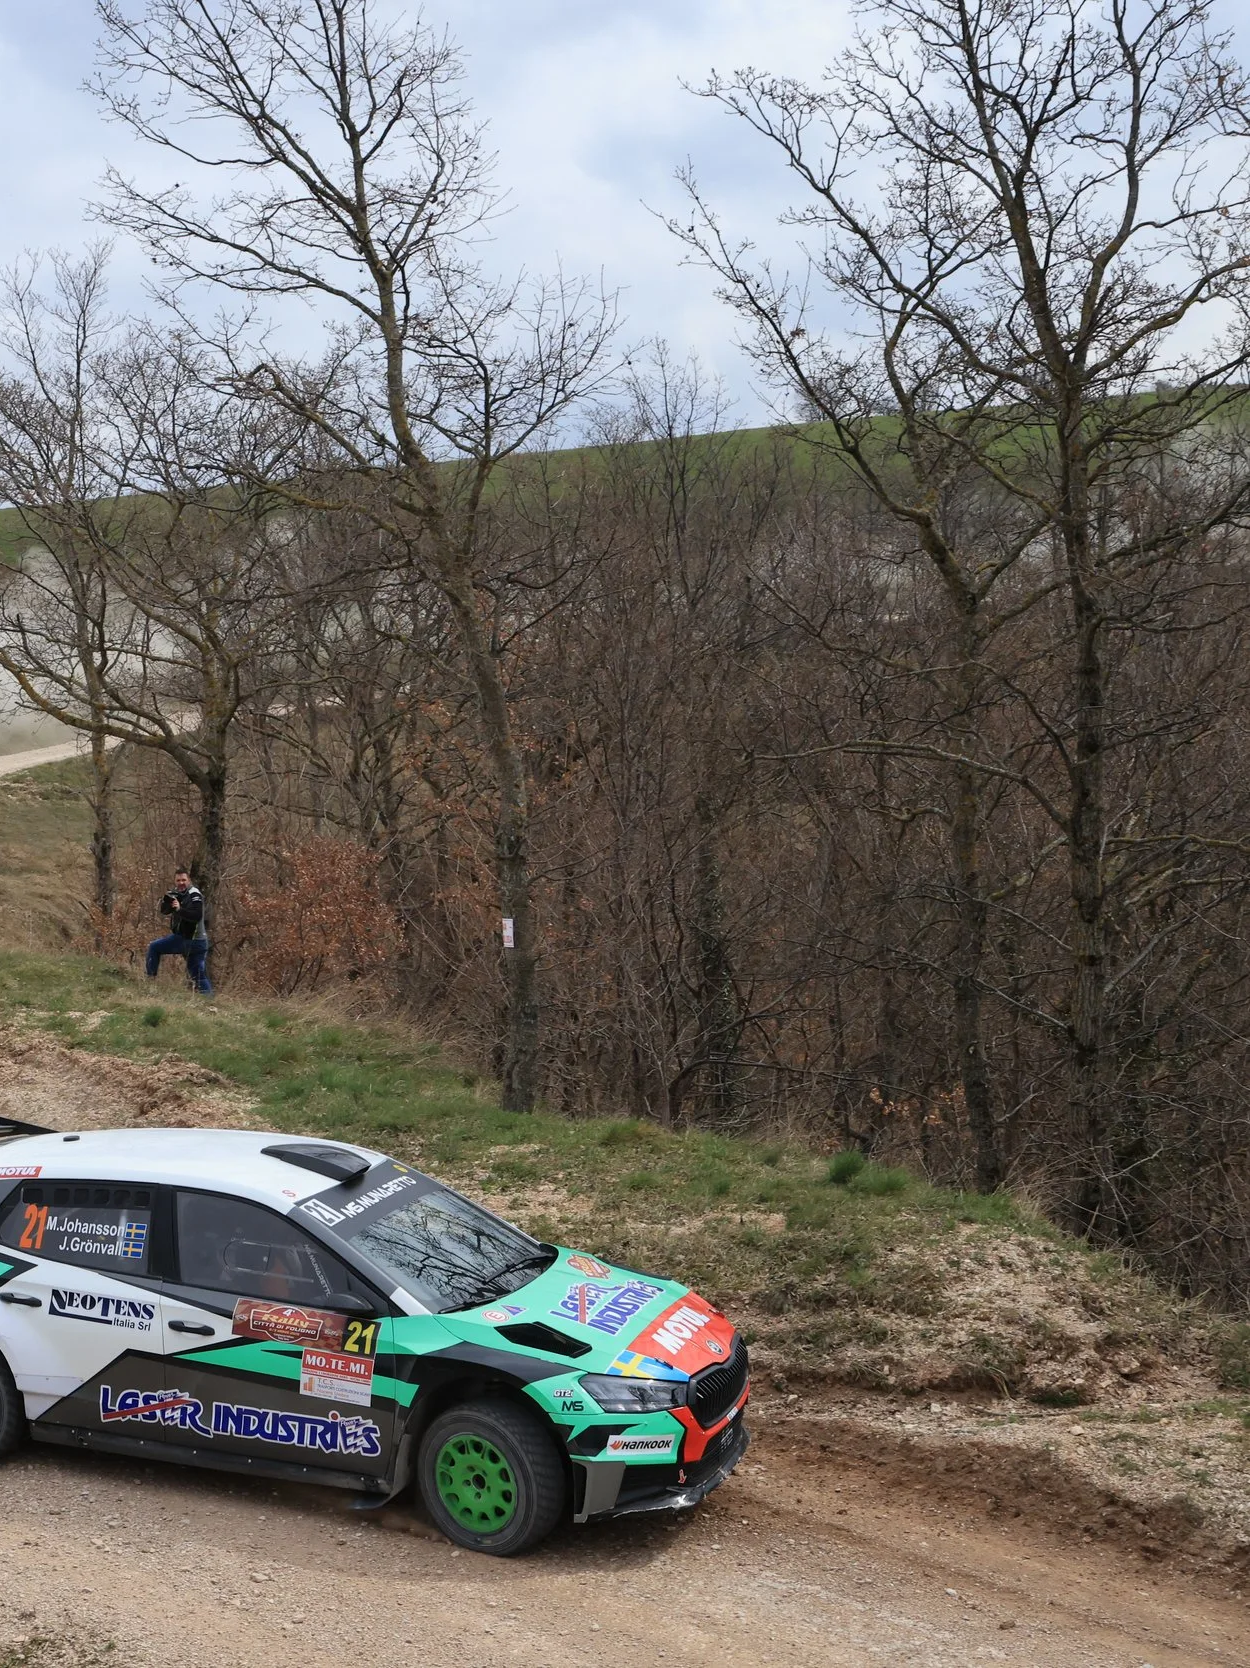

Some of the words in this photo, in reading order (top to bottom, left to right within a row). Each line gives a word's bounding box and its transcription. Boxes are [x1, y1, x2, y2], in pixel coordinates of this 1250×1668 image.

[341, 1201, 364, 1219] MS
[356, 1175, 417, 1209] MUNARETTO
[301, 1202, 341, 1223] 21
[19, 1203, 49, 1249] 21
[46, 1215, 125, 1238] M.Johansson
[58, 1235, 123, 1257] J.Grönvall
[49, 1288, 155, 1321] NEOTENS
[113, 1317, 136, 1330] Italia
[137, 1318, 151, 1331] Srl
[285, 1325, 317, 1335] FOLIGNO
[651, 1305, 711, 1355] MOTUL
[344, 1321, 376, 1355] 21
[305, 1354, 369, 1376] MO.TE.MI.
[553, 1389, 574, 1398] GT2i
[561, 1400, 585, 1412] MS
